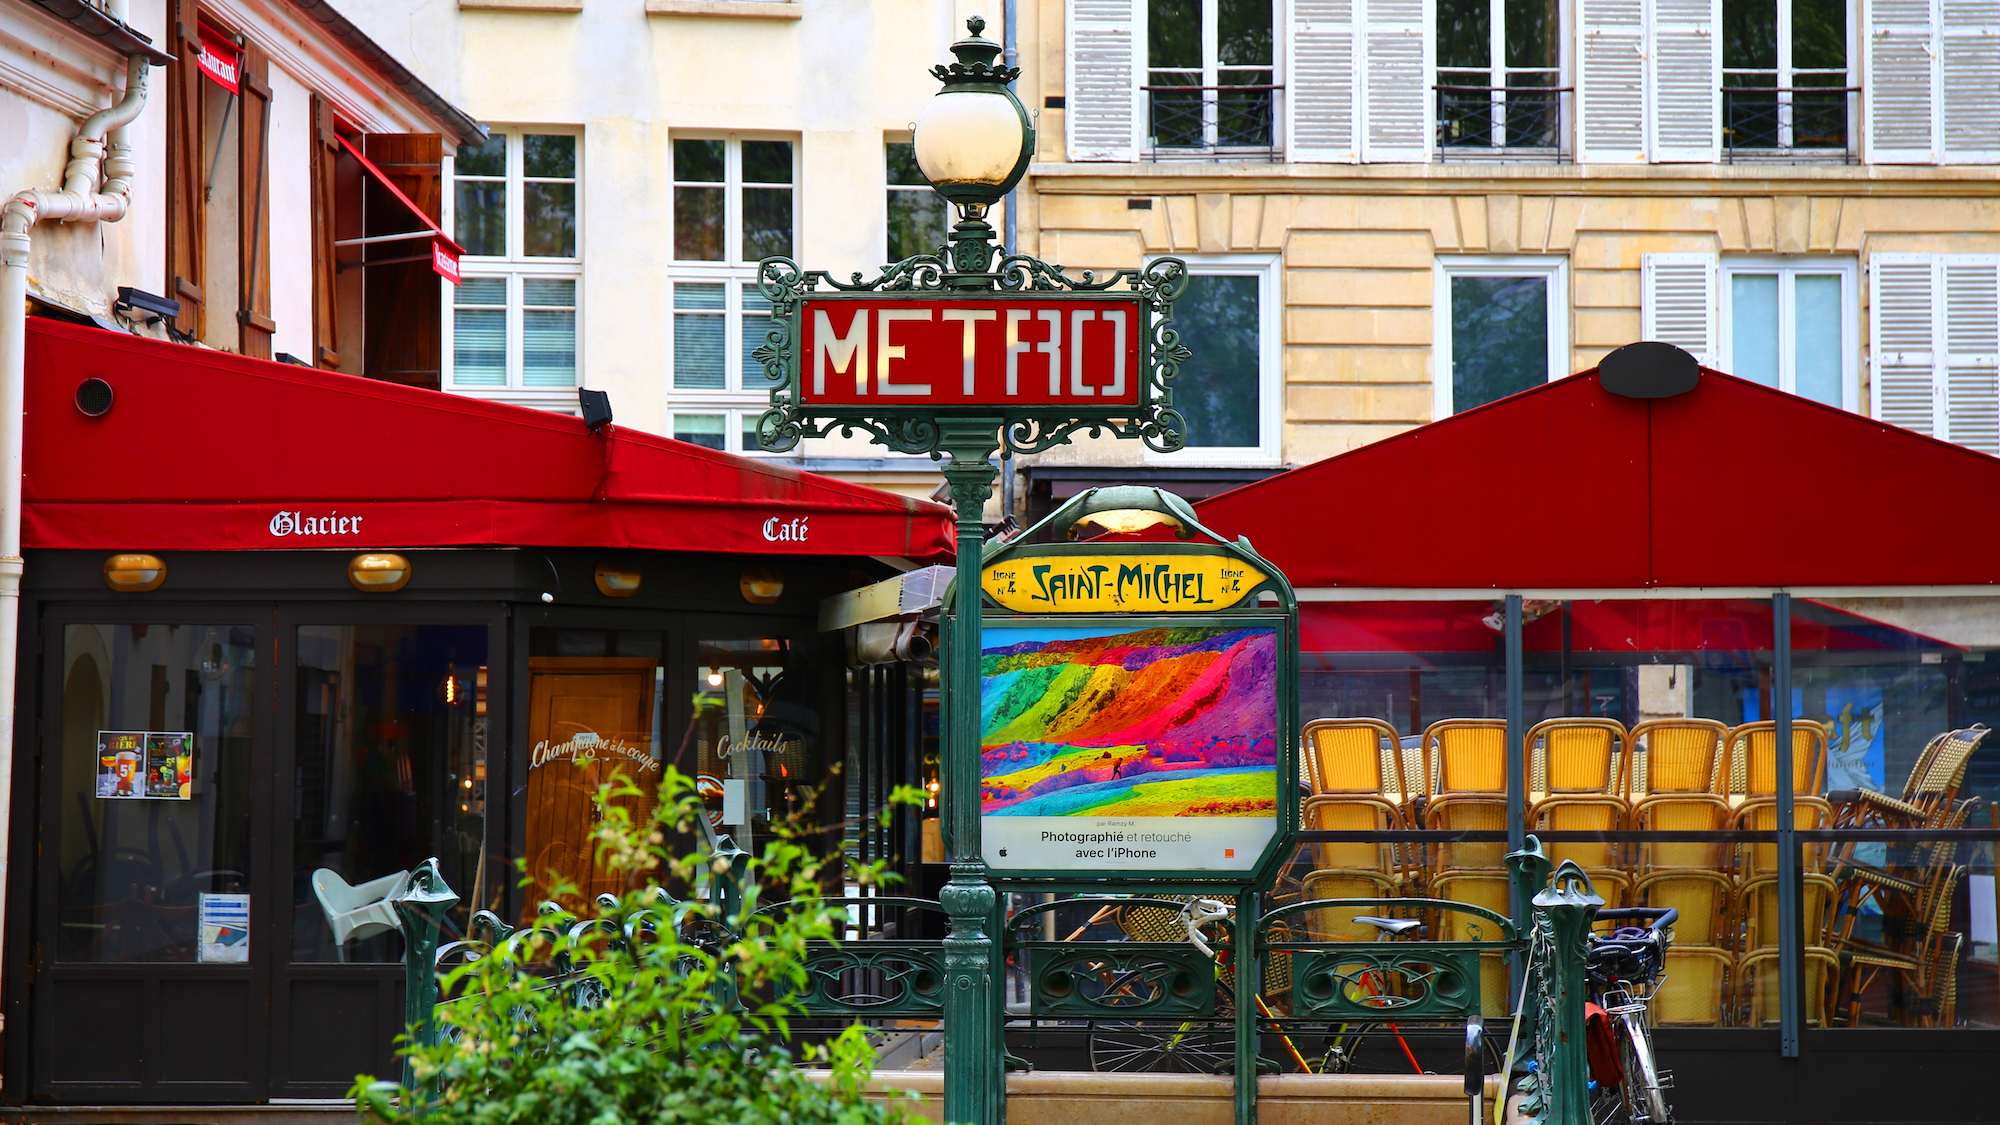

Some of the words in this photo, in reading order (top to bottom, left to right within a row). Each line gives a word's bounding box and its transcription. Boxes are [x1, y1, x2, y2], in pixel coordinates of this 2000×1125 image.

[813, 308, 1127, 397] METRO
[269, 510, 363, 537] Glacier
[763, 516, 809, 542] Café
[1007, 580, 1017, 595] 4
[1231, 579, 1241, 594] 4
[529, 738, 610, 770] Champagne
[616, 739, 626, 755] la
[626, 746, 660, 772] coupe
[717, 730, 787, 759] Cocktails
[1041, 831, 1124, 845] Photographié
[1126, 832, 1138, 842] et
[1141, 831, 1192, 842] retouché
[1075, 849, 1104, 858] avec
[1107, 847, 1157, 858] l'iPhone
